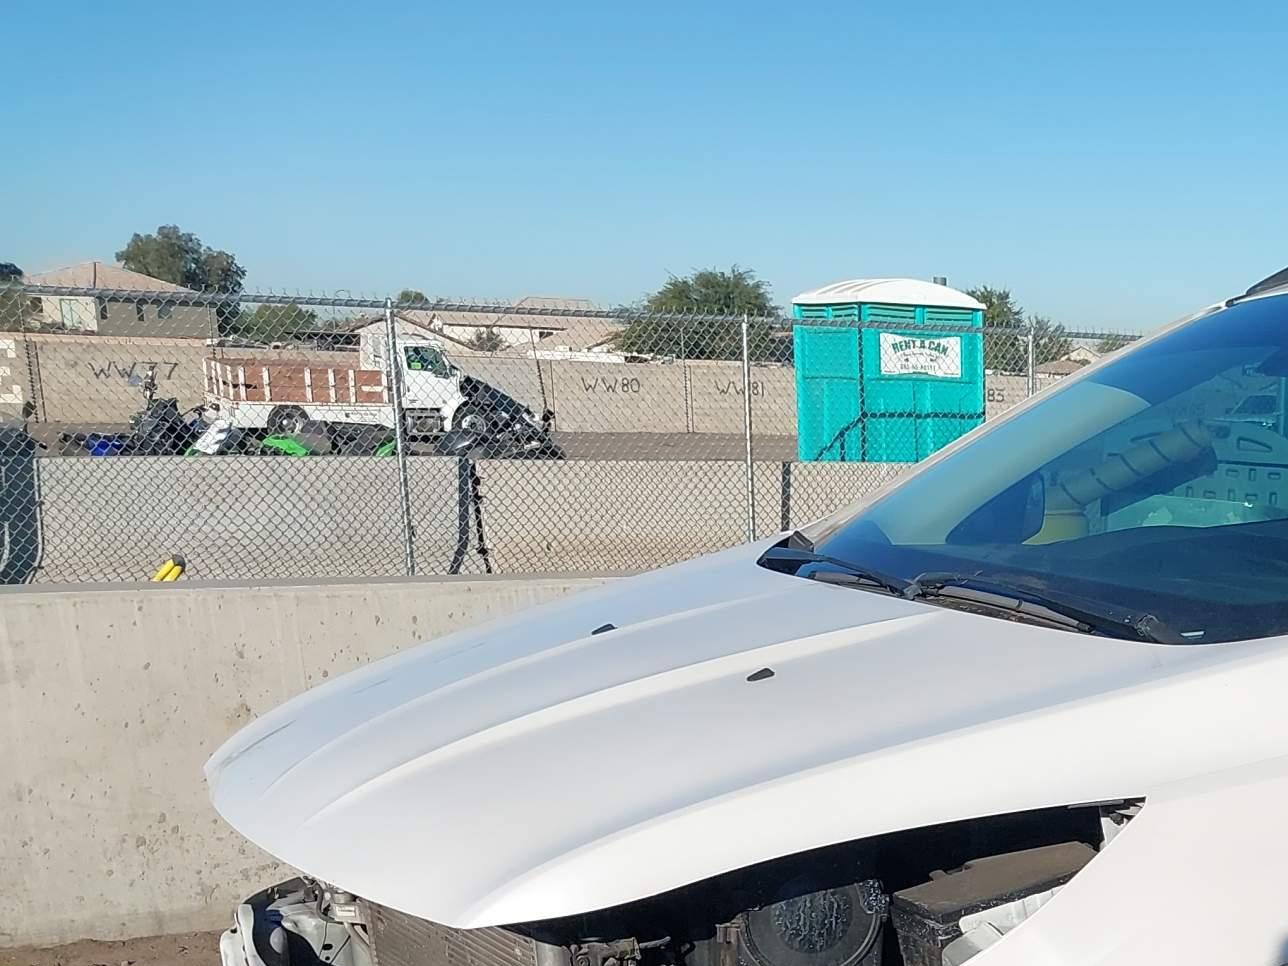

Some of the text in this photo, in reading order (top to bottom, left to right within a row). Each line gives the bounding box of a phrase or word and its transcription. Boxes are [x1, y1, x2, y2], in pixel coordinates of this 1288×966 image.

[891, 339, 916, 354] RENT
[918, 339, 926, 349] A
[927, 340, 949, 356] CAN
